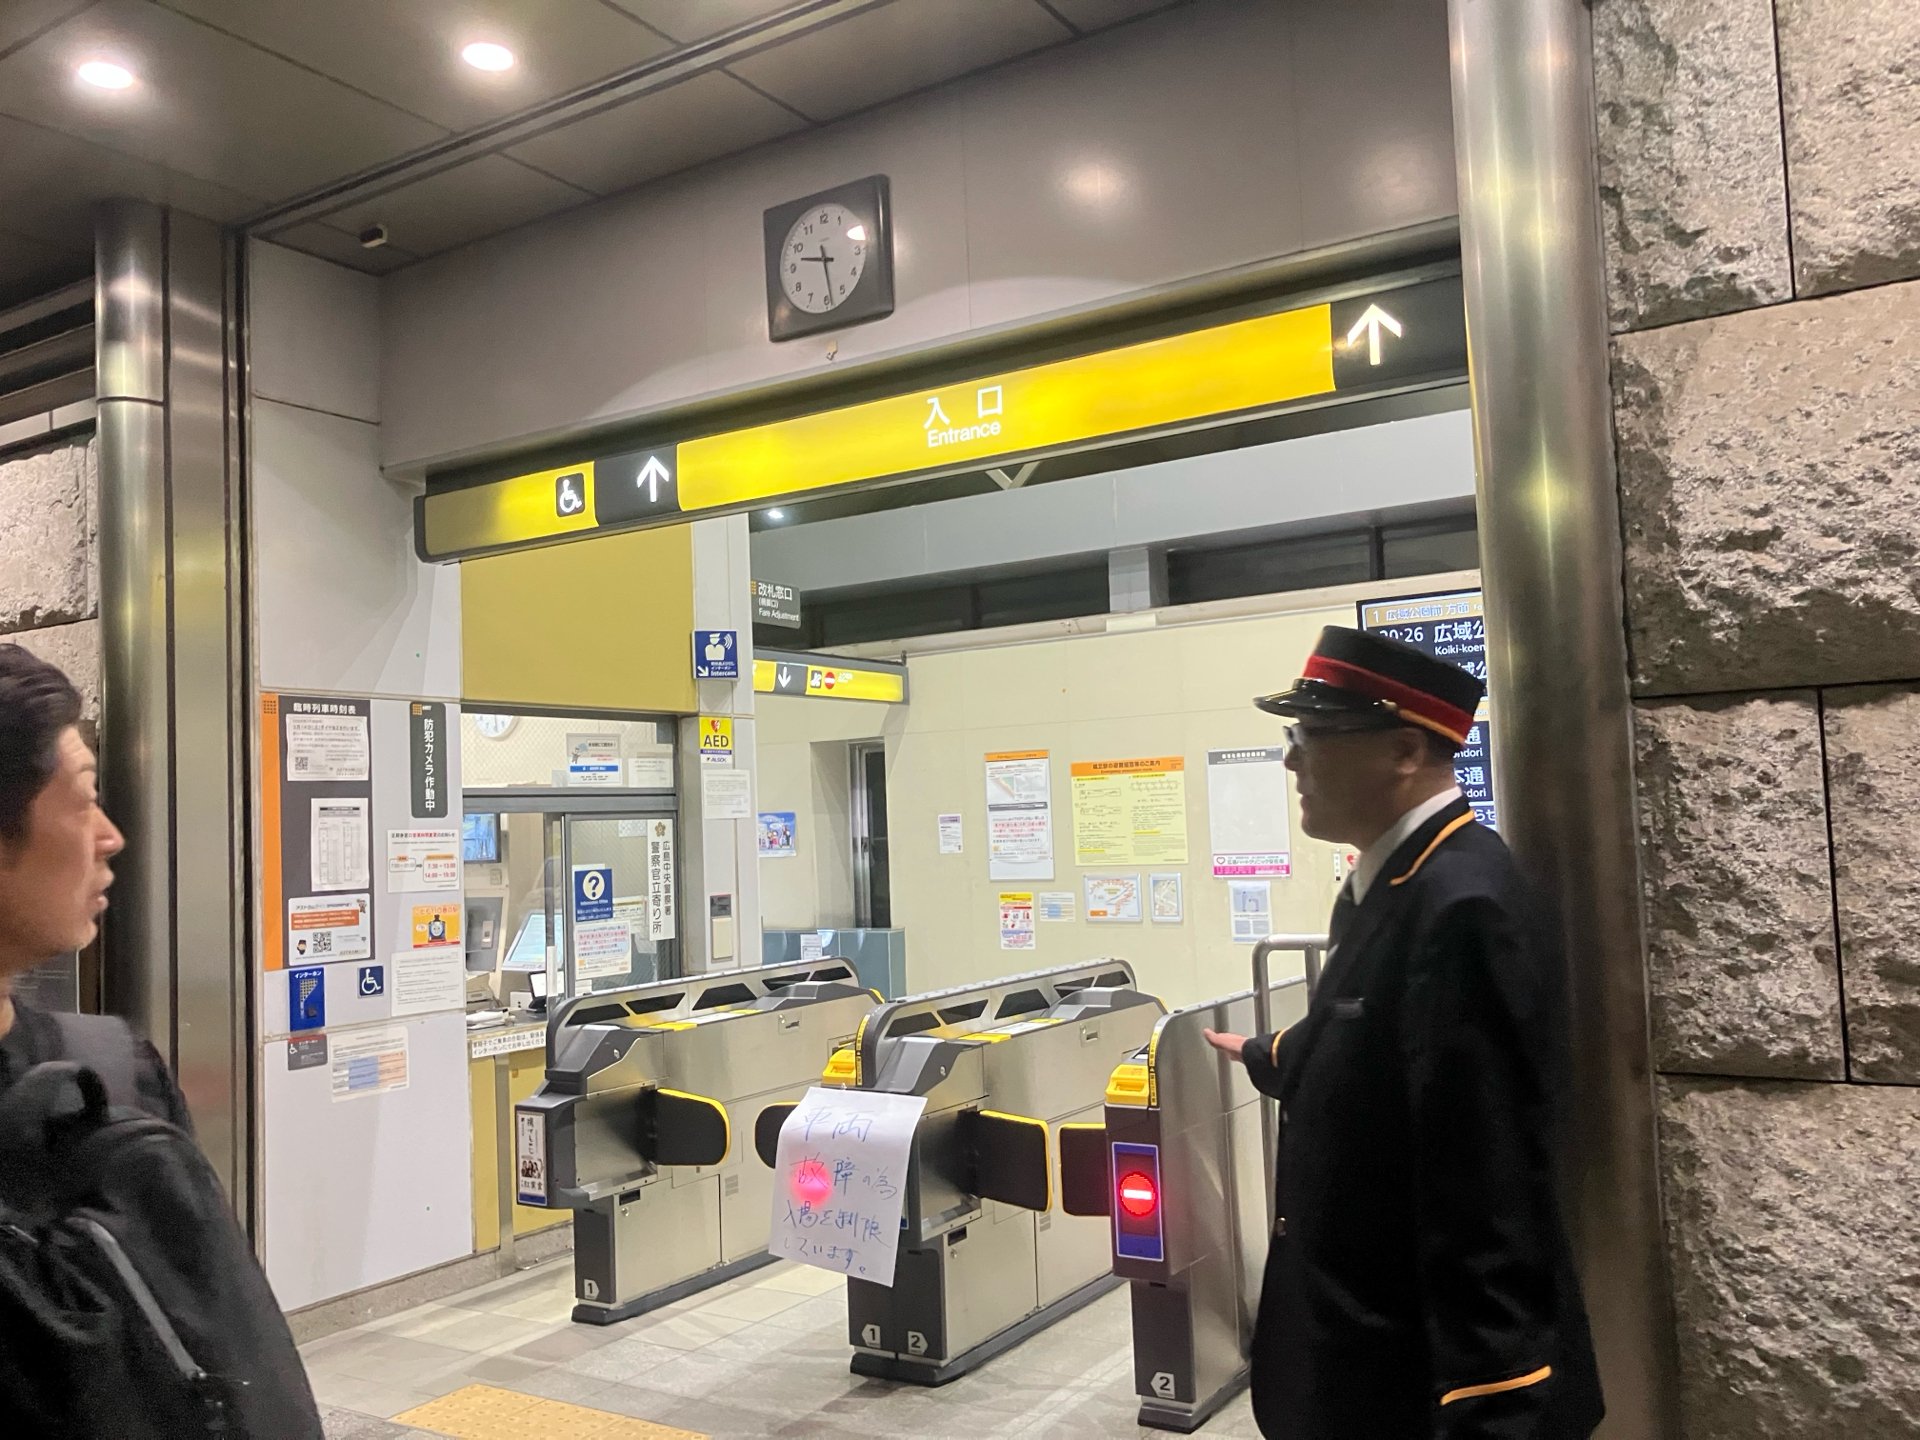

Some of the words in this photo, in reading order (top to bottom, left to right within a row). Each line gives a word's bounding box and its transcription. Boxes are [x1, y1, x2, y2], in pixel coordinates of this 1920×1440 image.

[923, 385, 1003, 430] 入口
[927, 421, 1001, 448] Entrance
[758, 582, 793, 601] 改札窓口
[758, 607, 771, 617] Fare
[771, 609, 800, 622] Adjustment
[1373, 610, 1379, 623] 1
[1446, 602, 1469, 615] 方面
[703, 734, 729, 748] AED
[423, 718, 436, 813] 防犯カメラ作動中
[651, 841, 662, 934] 警察官立寄り所
[294, 969, 322, 979] インターホン
[587, 1282, 593, 1295] 1
[869, 1328, 875, 1341] 1
[911, 1334, 921, 1348] 2
[1159, 1376, 1171, 1391] 2
